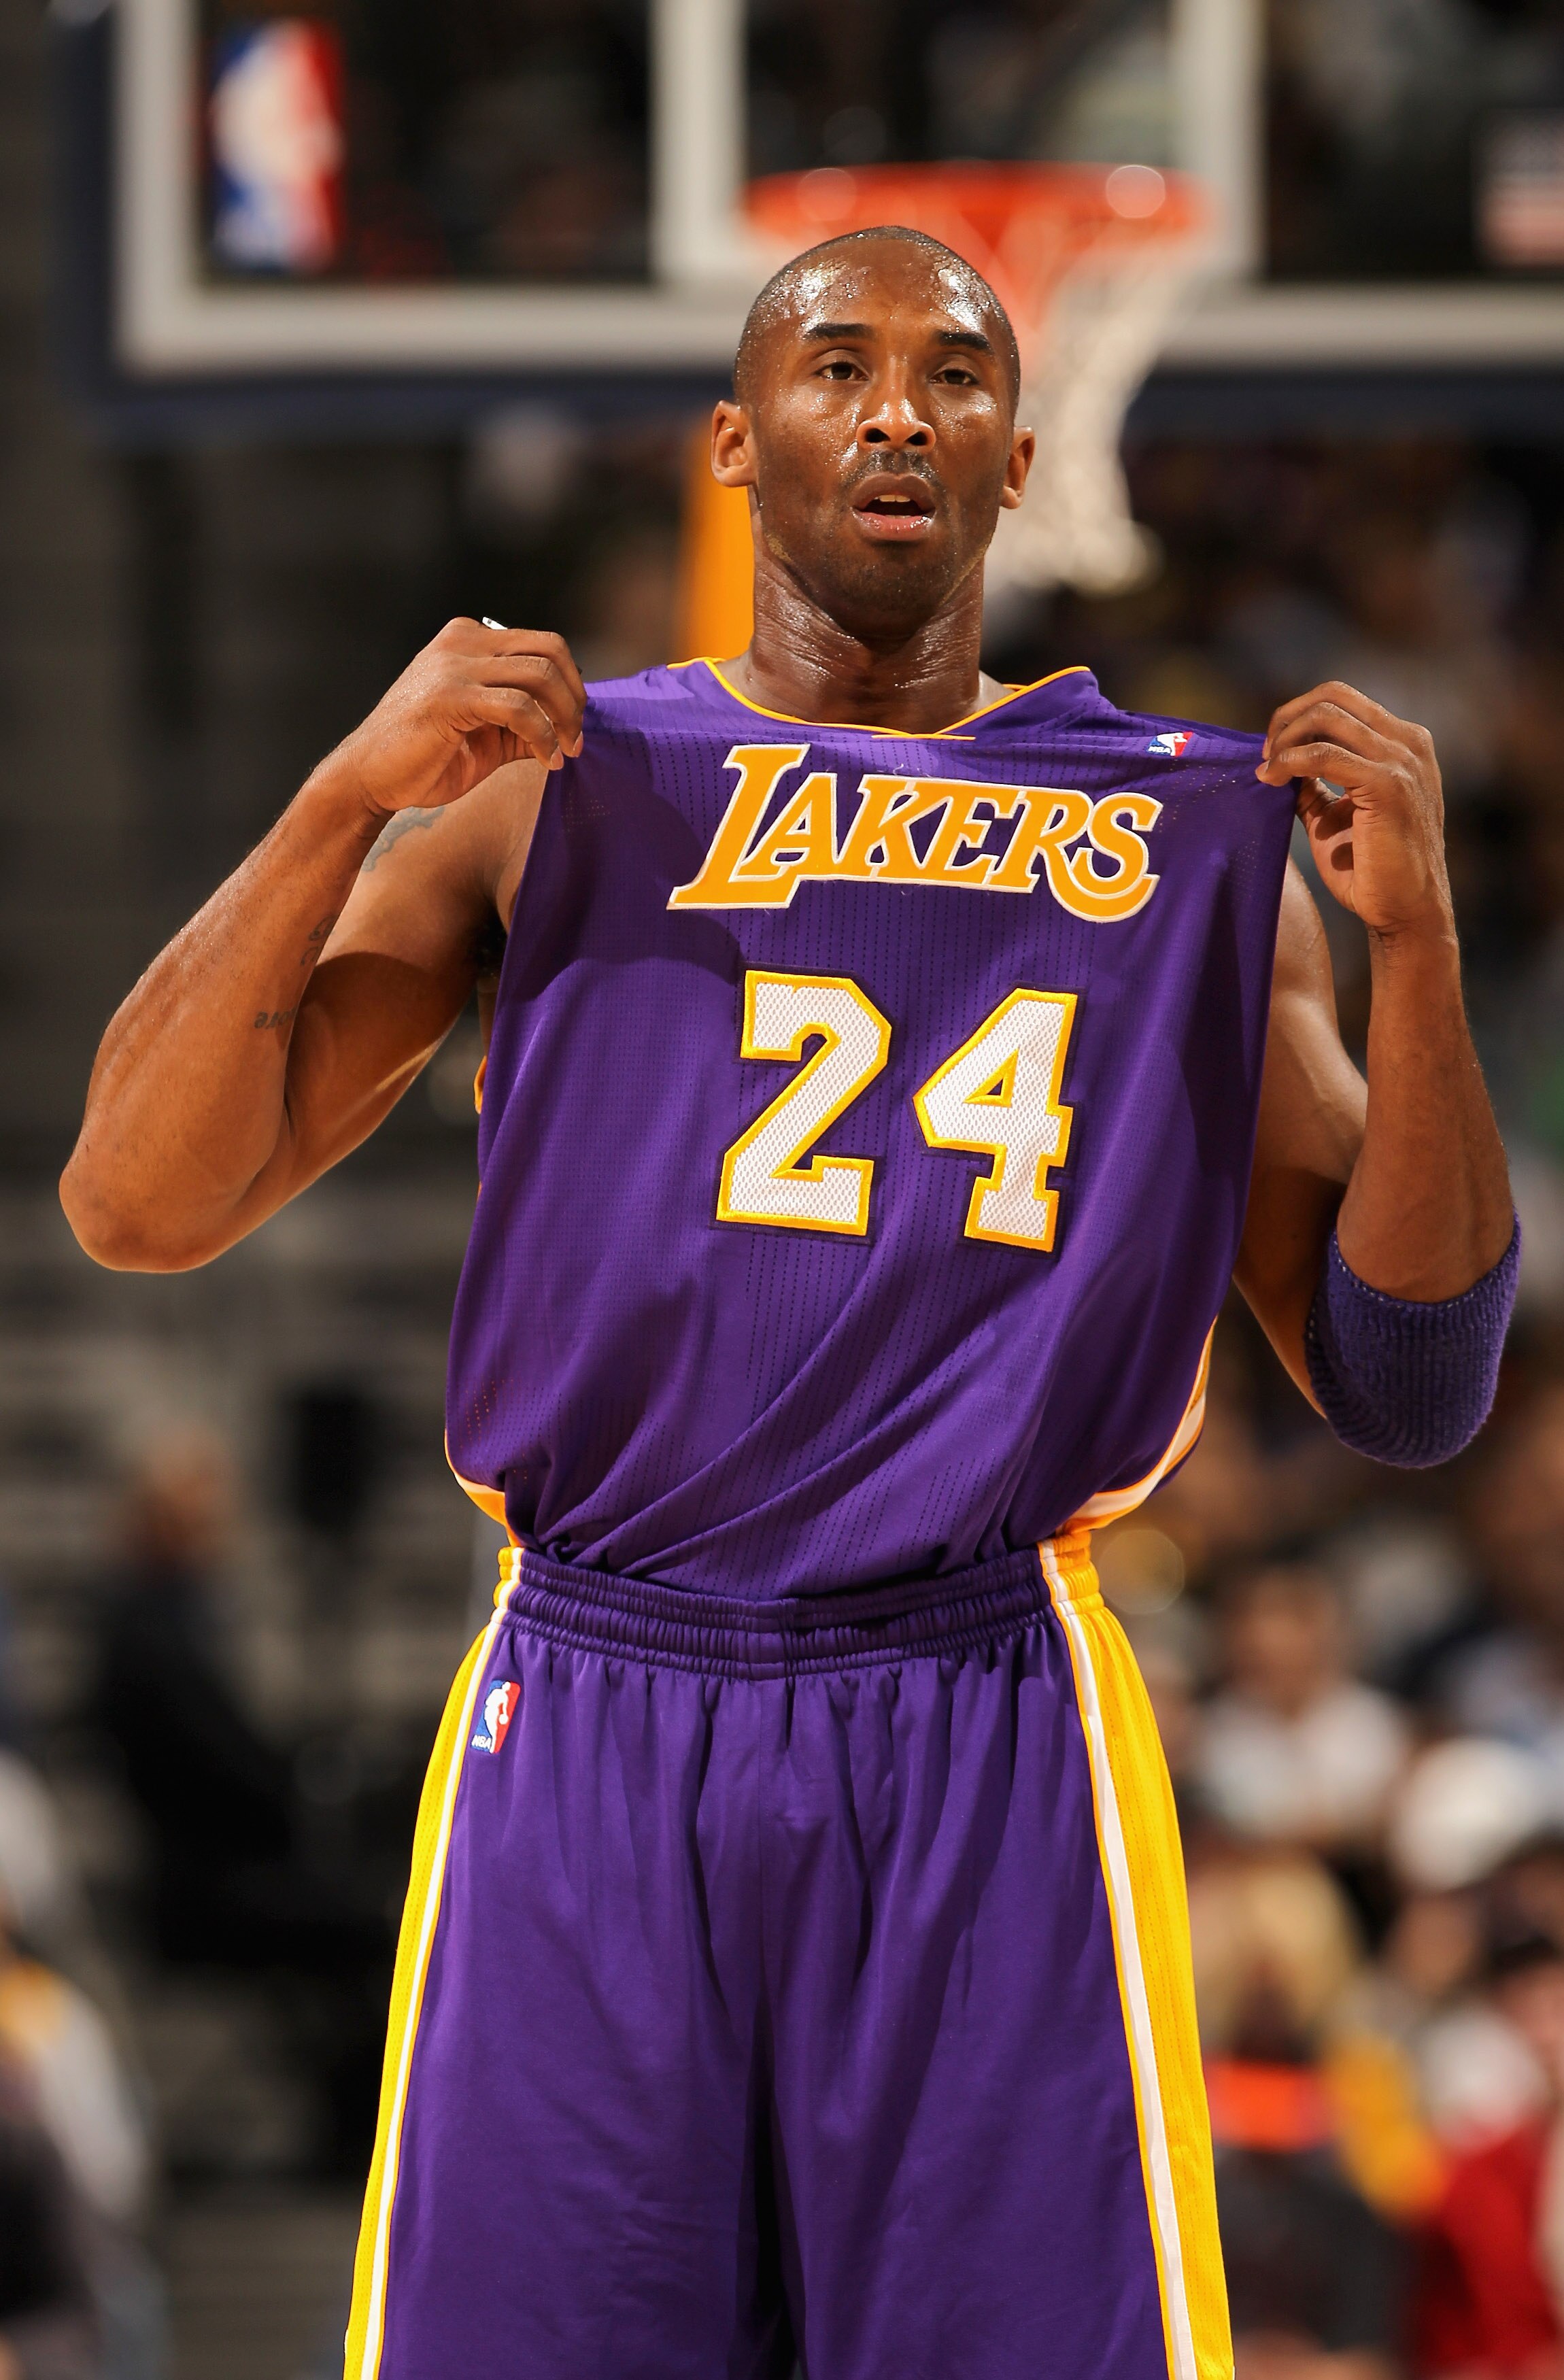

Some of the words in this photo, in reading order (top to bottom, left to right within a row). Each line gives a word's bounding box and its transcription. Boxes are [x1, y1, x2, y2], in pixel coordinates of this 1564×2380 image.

[1148, 746, 1171, 754] NBA
[667, 743, 1163, 922] LAKERS
[716, 970, 1077, 1252] 24
[472, 1735, 491, 1749] NBA
